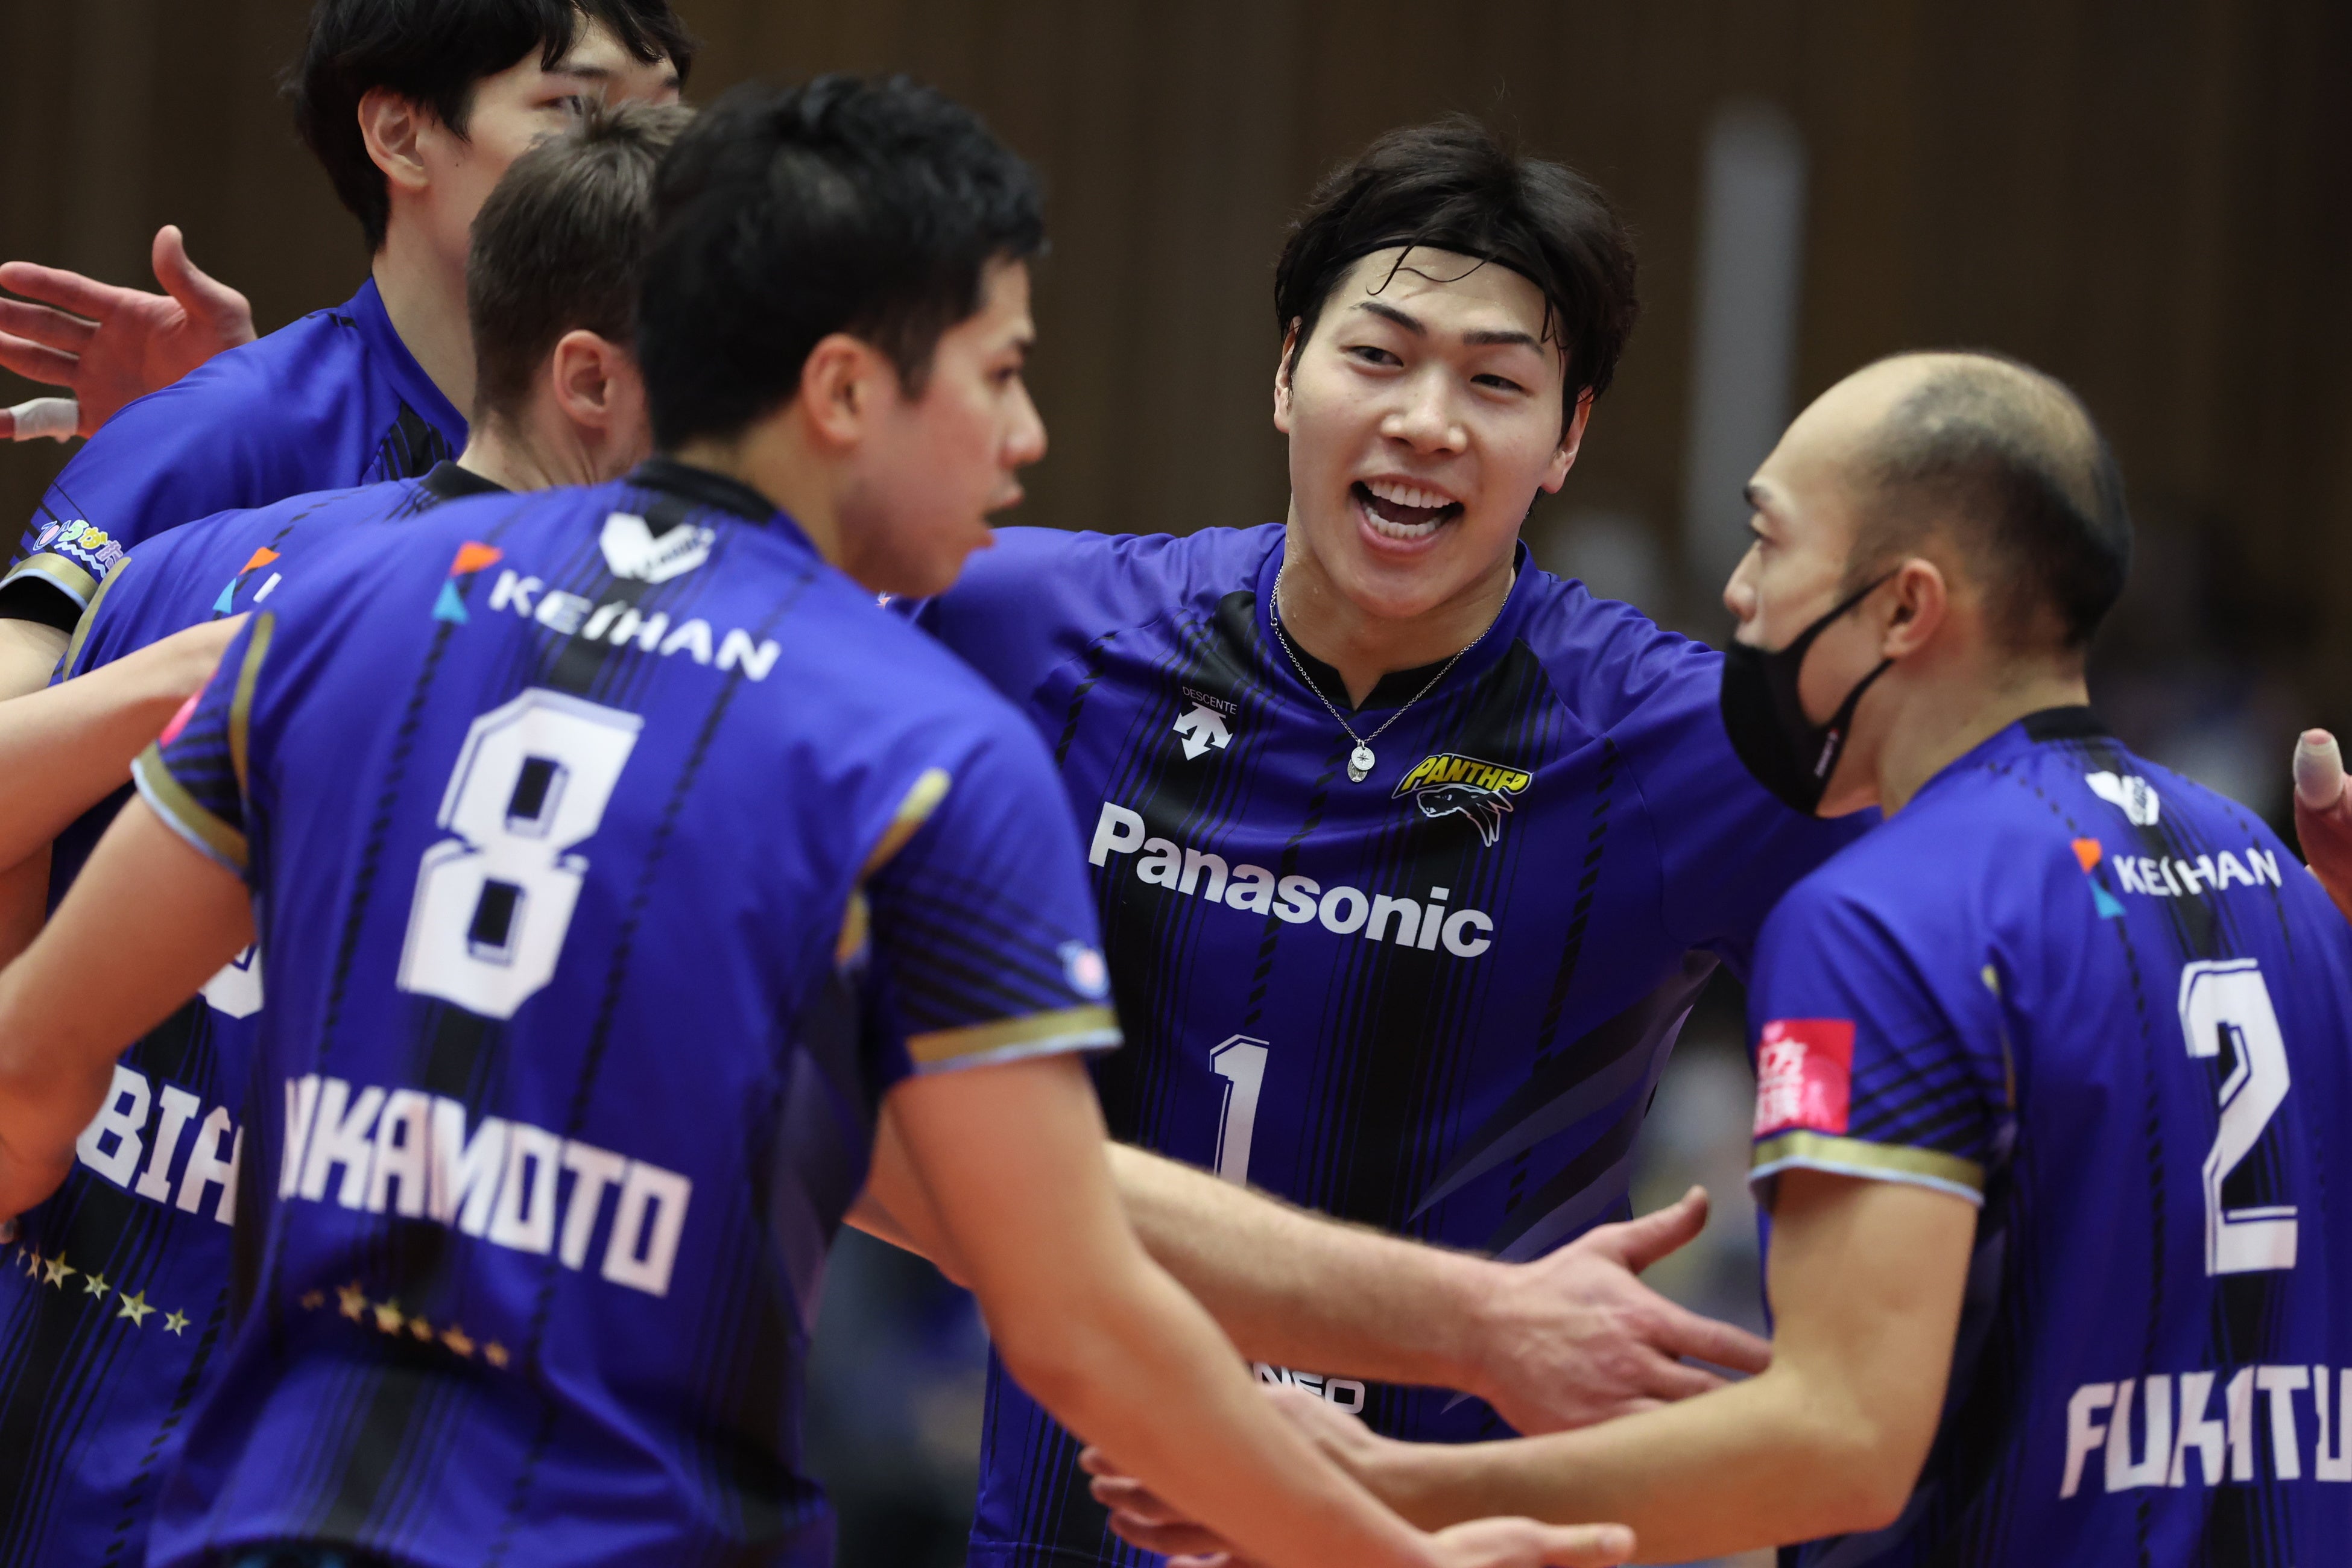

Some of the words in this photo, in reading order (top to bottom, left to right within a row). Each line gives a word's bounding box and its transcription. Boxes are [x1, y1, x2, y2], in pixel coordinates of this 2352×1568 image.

[489, 569, 781, 681] KEIHAN
[1182, 686, 1238, 715] DESCENTE
[396, 687, 645, 1020] 8
[1088, 801, 1494, 957] Panasonic
[2113, 847, 2283, 897] KEIHAN
[1209, 1034, 1269, 1188] 1
[2178, 958, 2298, 1277] 2
